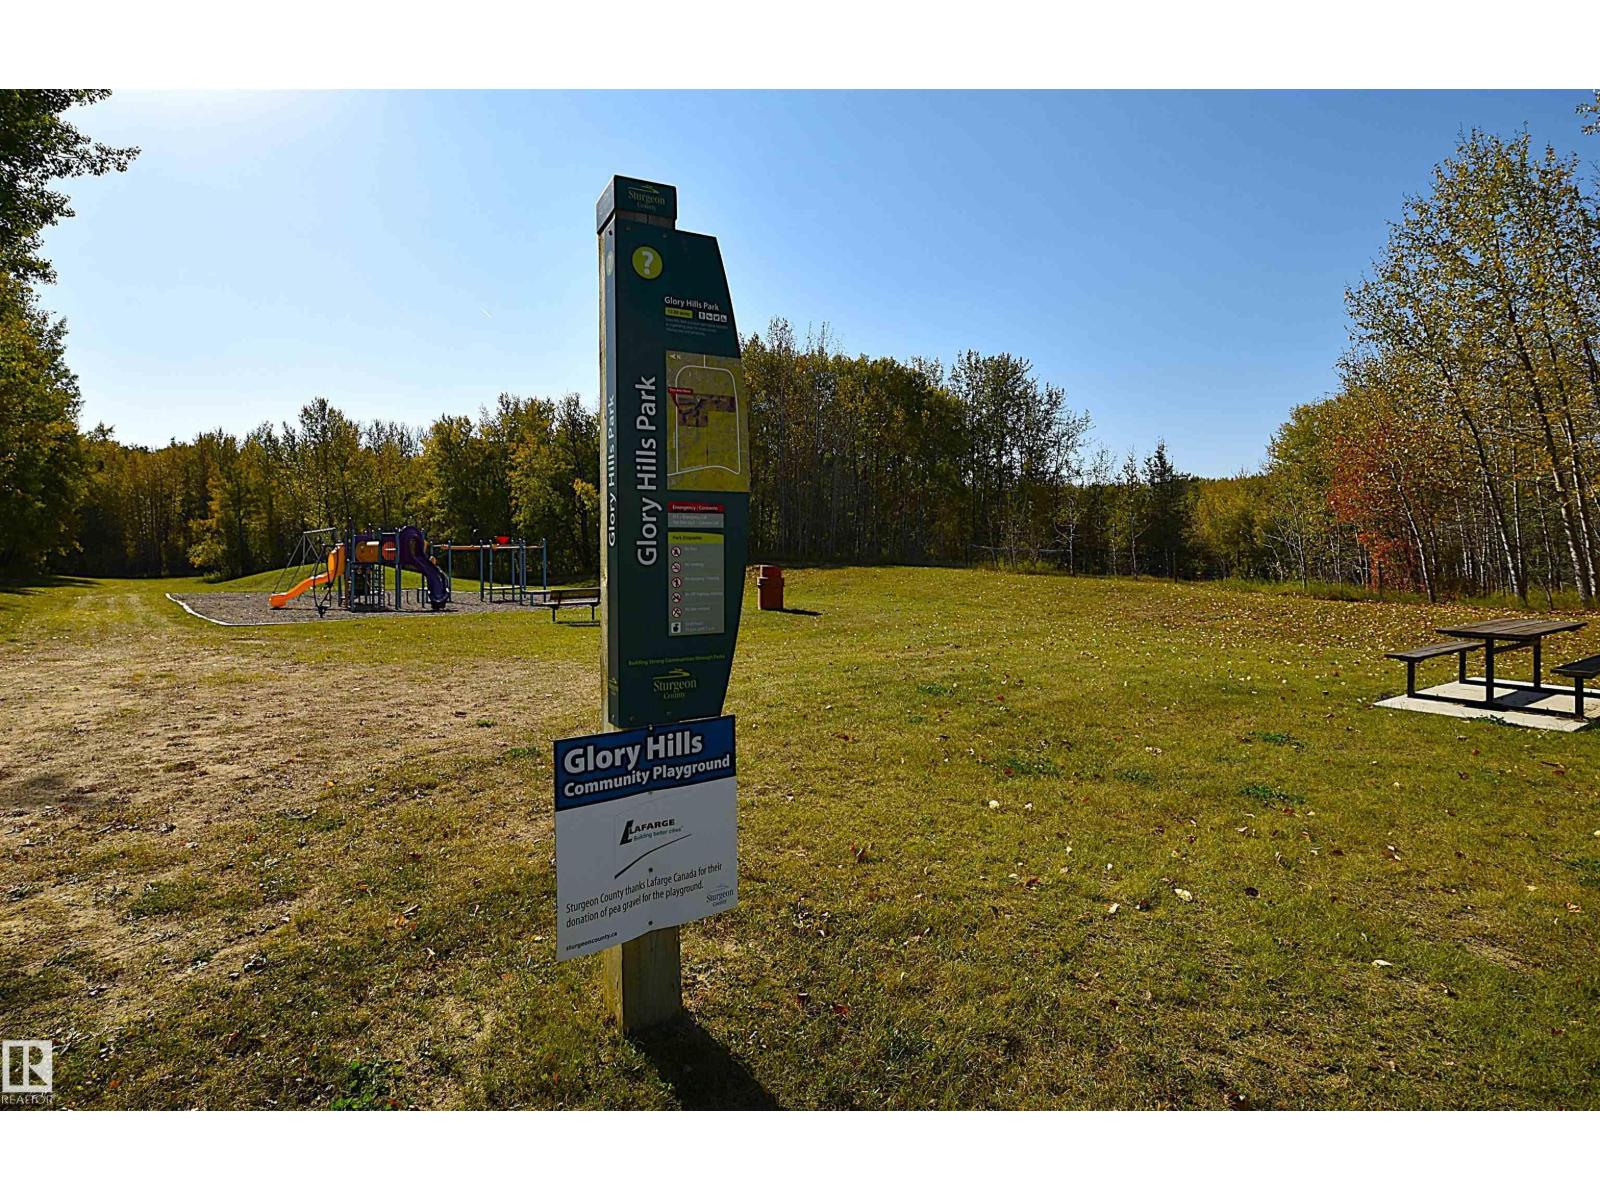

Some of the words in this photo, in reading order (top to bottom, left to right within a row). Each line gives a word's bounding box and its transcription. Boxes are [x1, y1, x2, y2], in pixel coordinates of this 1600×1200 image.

[664, 296, 685, 307] Glory
[686, 299, 702, 309] Hills
[703, 301, 720, 311] Park
[635, 376, 656, 430] Park
[636, 438, 656, 490] Hills
[608, 493, 617, 546] Glory
[636, 497, 662, 566] Glory
[653, 679, 697, 692] Sturgeon
[564, 744, 641, 774] Glory
[647, 731, 703, 760] Hills
[564, 770, 650, 797] Community
[653, 754, 730, 780] Playground
[633, 832, 653, 841] Building
[653, 829, 668, 837] better
[566, 896, 599, 914] Sturgeon
[600, 888, 624, 903] County
[625, 881, 646, 894] thanks
[646, 874, 672, 888] Lafarge
[673, 868, 697, 882] Canada
[697, 865, 707, 876] for
[707, 862, 723, 873] their
[566, 909, 599, 928] donation
[600, 907, 608, 918] of
[608, 904, 622, 918] pea
[622, 894, 642, 912] gravel
[642, 892, 652, 903] for
[652, 889, 665, 900] the
[665, 880, 704, 900] playground.
[706, 888, 734, 903] Sturgeon
[566, 931, 618, 951] sturgeoncounty.ca
